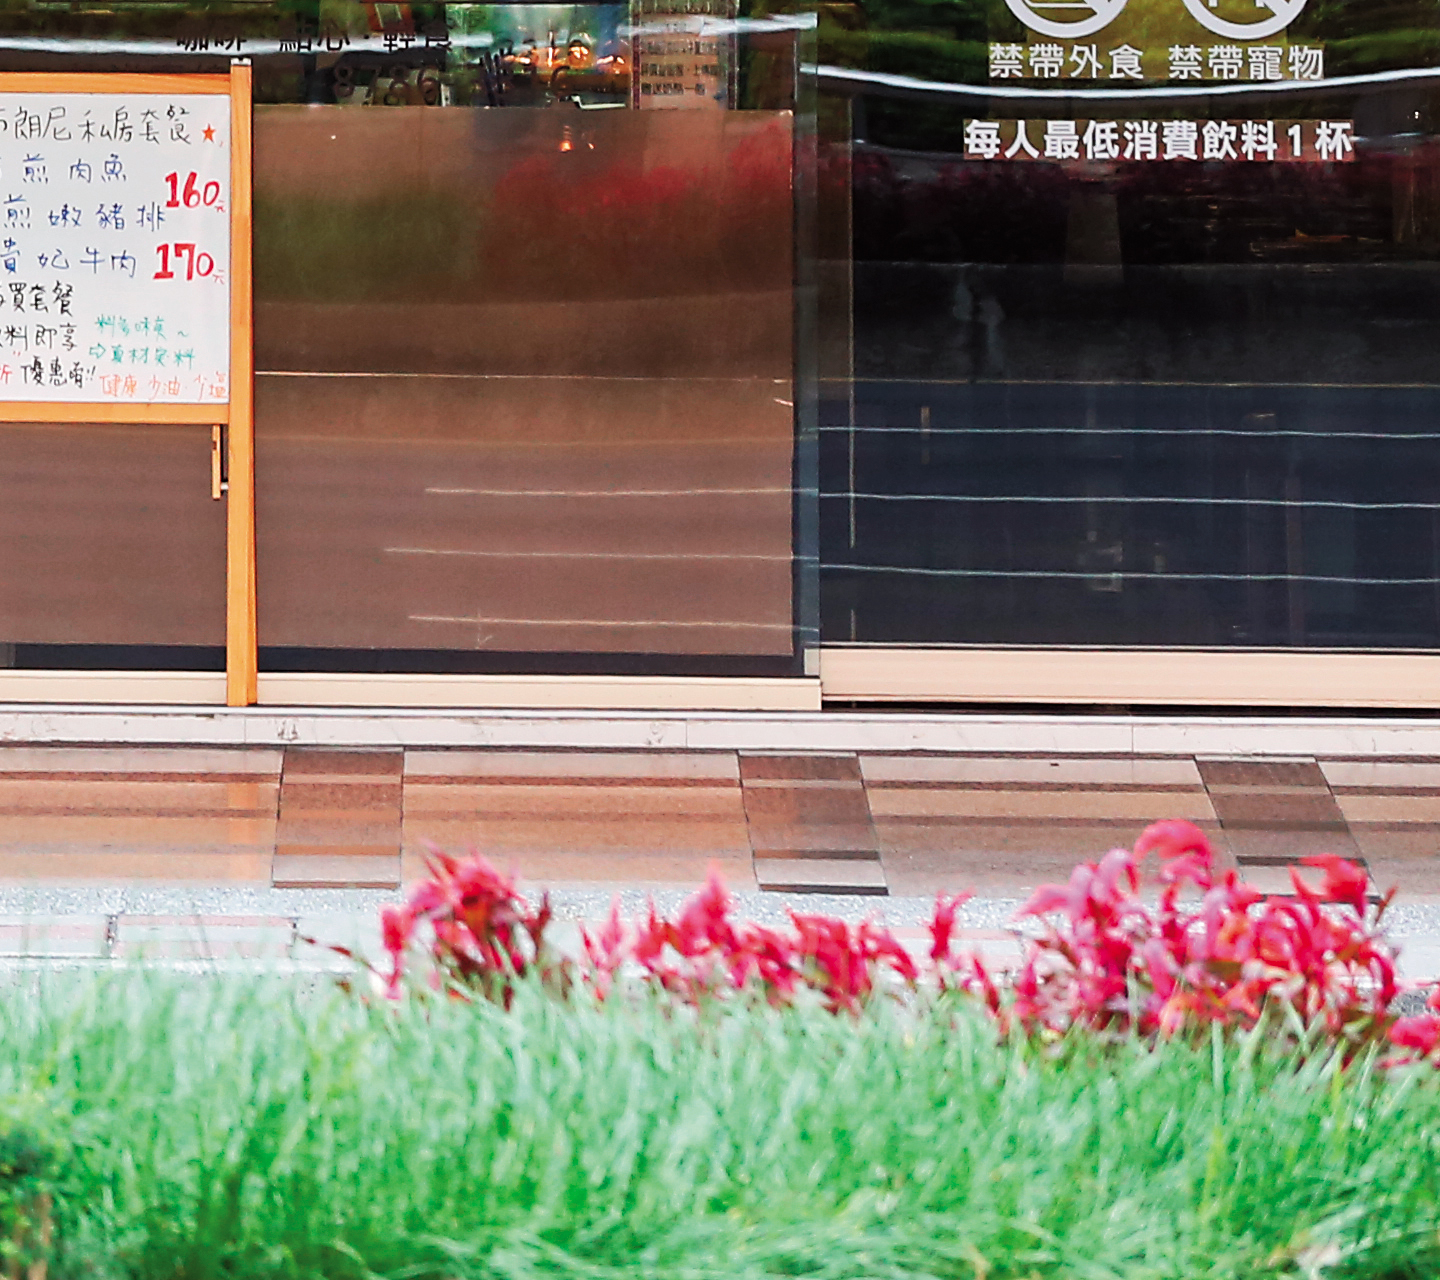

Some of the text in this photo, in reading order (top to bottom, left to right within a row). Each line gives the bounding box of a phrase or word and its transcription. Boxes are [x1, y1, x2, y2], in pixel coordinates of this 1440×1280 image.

[989, 44, 1144, 79] 禁帶外食
[1168, 45, 1325, 80] 禁帶寵物
